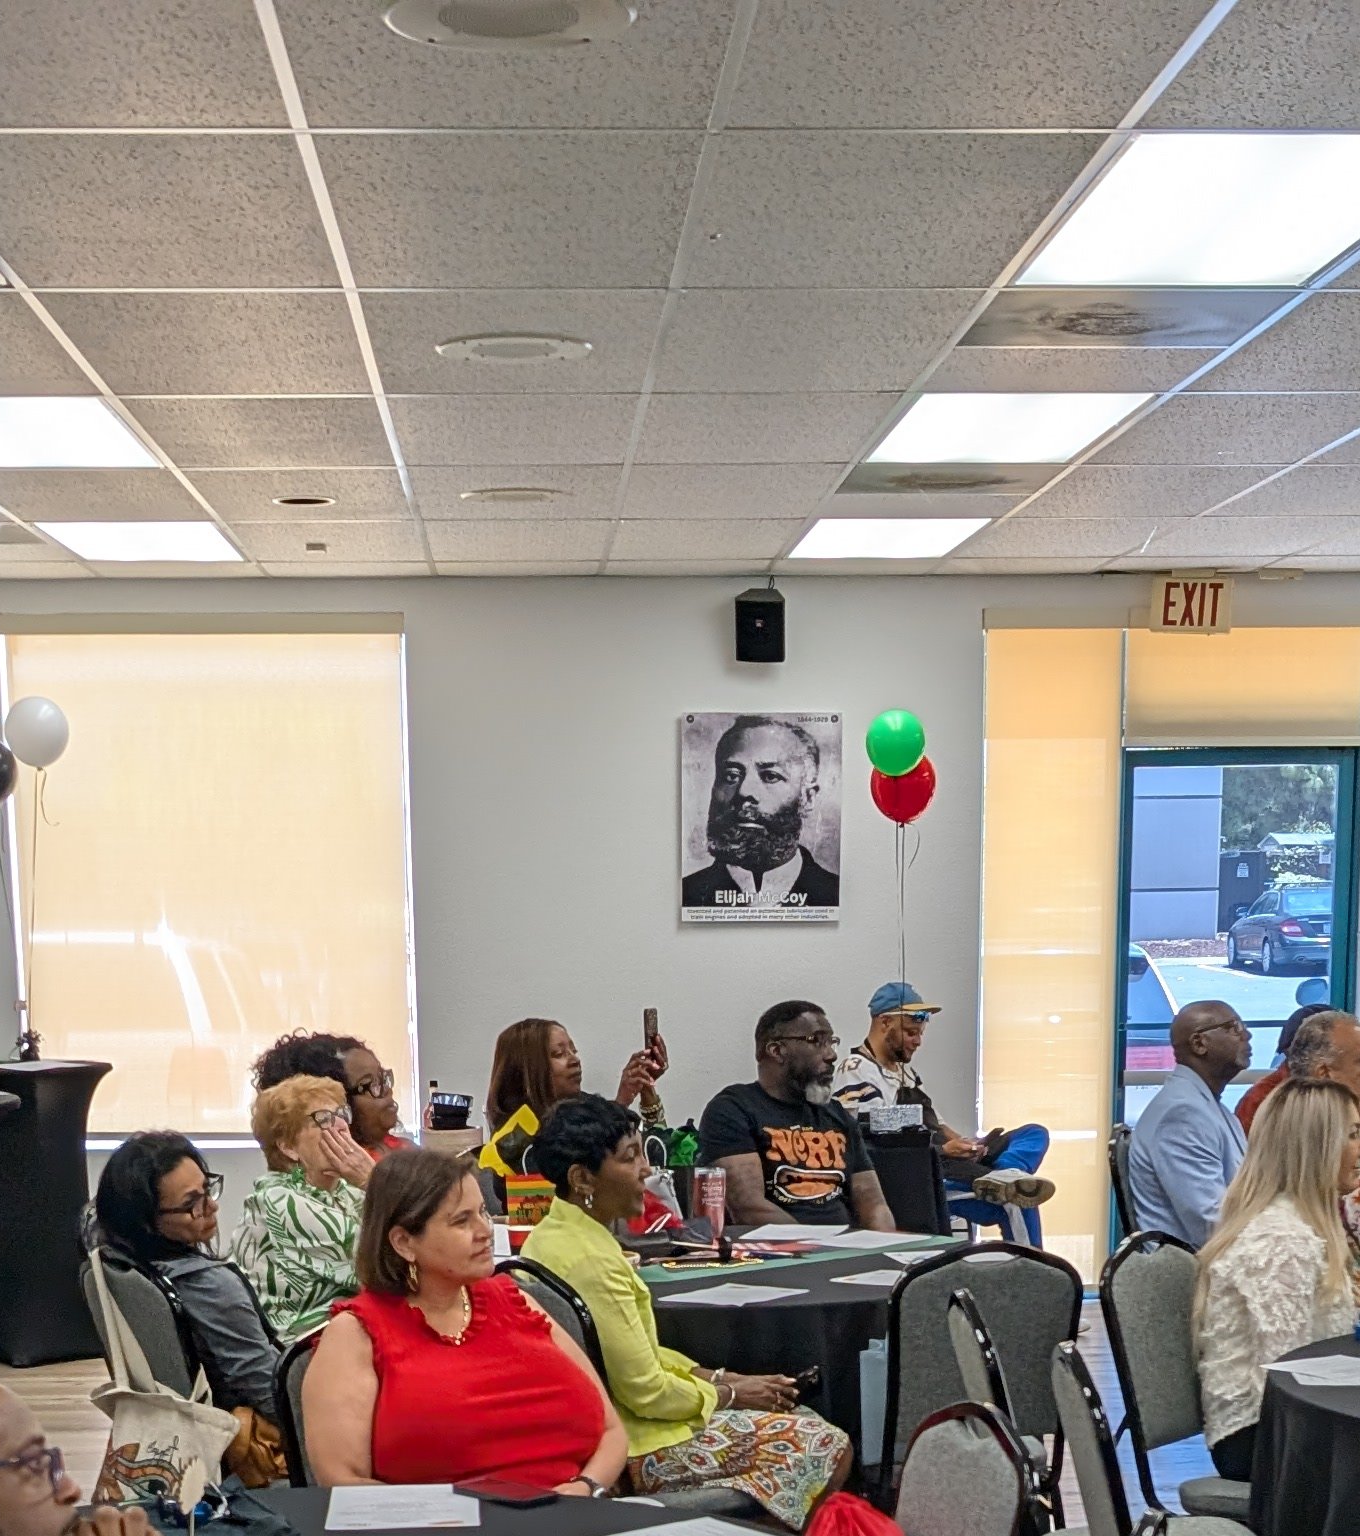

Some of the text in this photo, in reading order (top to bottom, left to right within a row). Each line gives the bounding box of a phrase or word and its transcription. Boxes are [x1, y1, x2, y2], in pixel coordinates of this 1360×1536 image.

[1162, 582, 1224, 626] EXIT
[714, 889, 809, 907] Elijah McCoy
